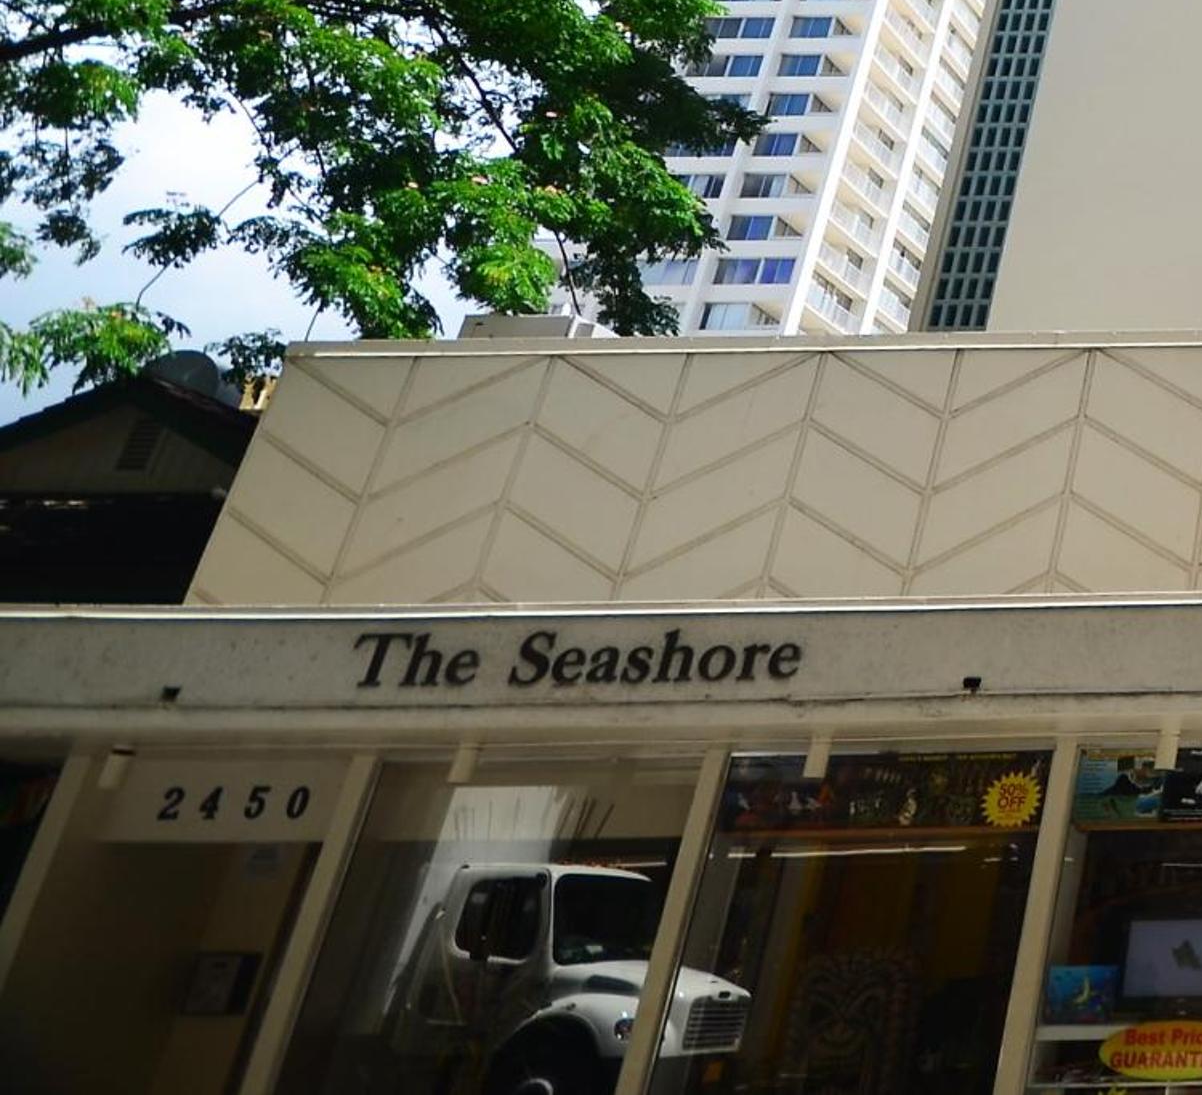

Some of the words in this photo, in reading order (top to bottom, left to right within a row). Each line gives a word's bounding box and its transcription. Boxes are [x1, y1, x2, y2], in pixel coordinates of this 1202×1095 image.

[353, 631, 480, 688] The
[508, 629, 802, 689] Seashore
[157, 786, 311, 821] 2450
[998, 796, 1025, 808] OFF
[1125, 1028, 1165, 1046] Best
